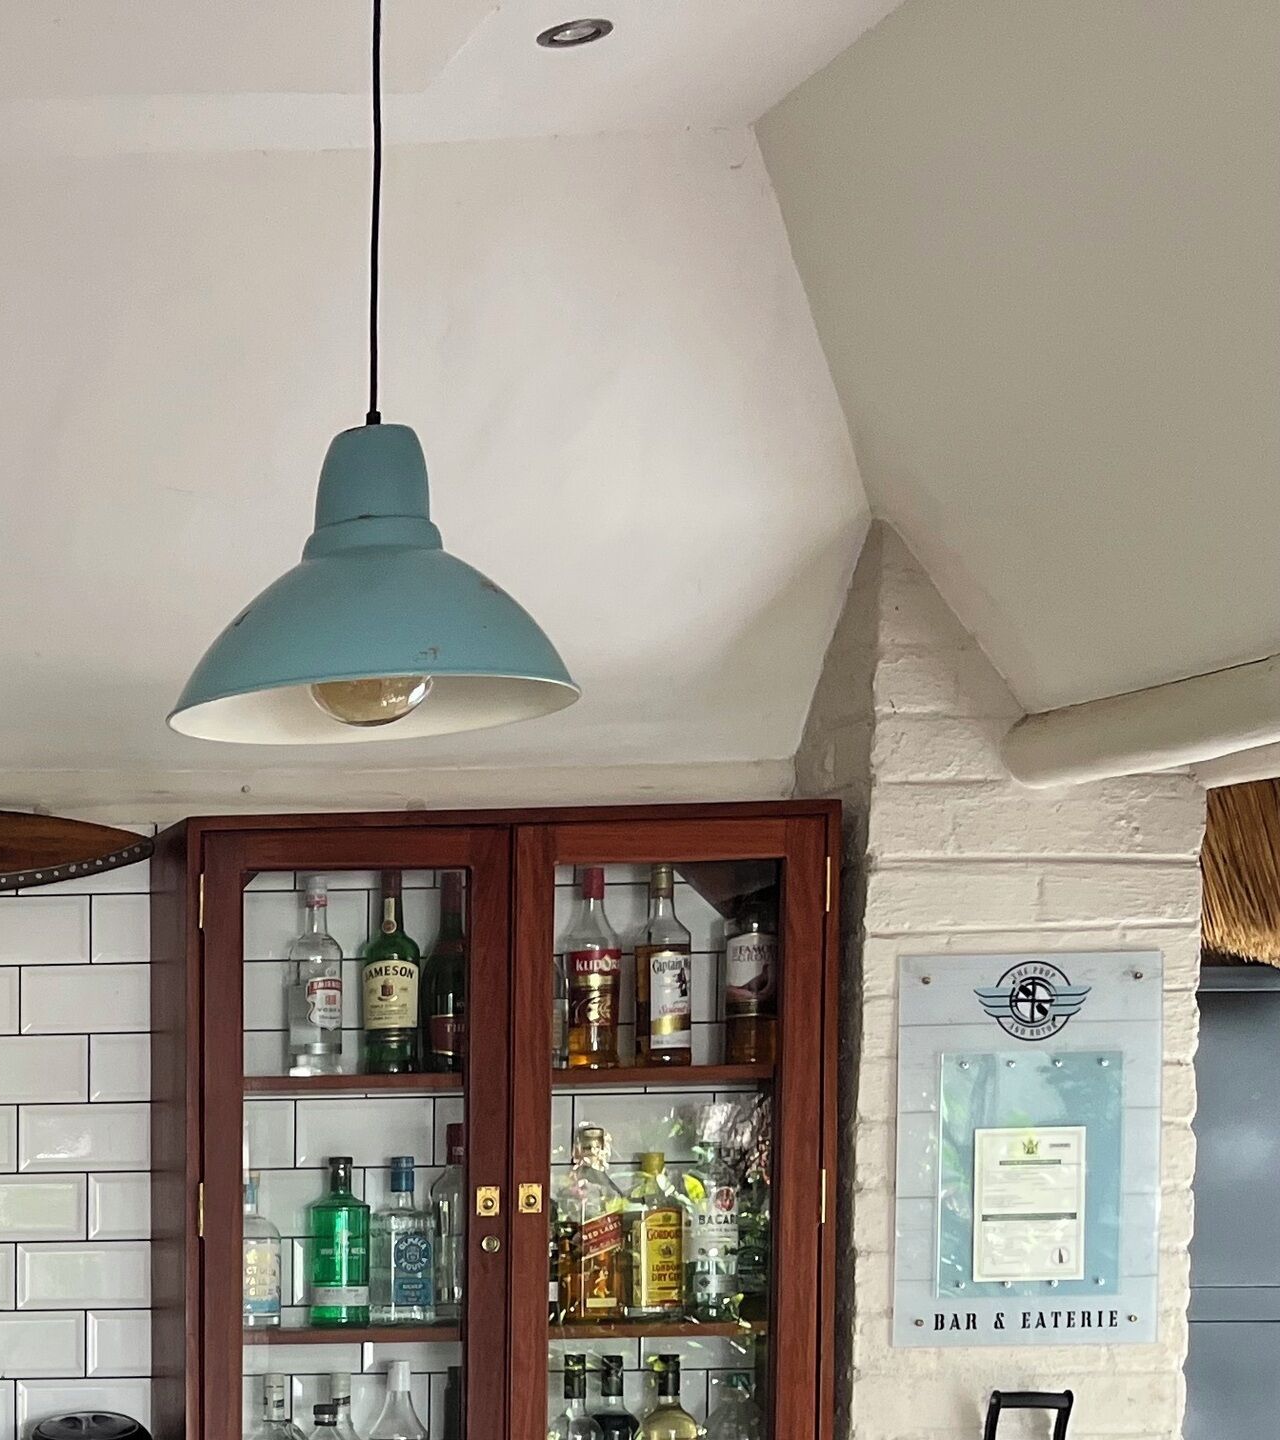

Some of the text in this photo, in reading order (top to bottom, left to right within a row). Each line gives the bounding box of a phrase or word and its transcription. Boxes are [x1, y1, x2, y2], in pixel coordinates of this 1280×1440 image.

[364, 965, 415, 983] JAMESON
[652, 958, 682, 974] Captain
[1032, 966, 1056, 979] PROP
[933, 1310, 1119, 1331] BAR & EATERIE
